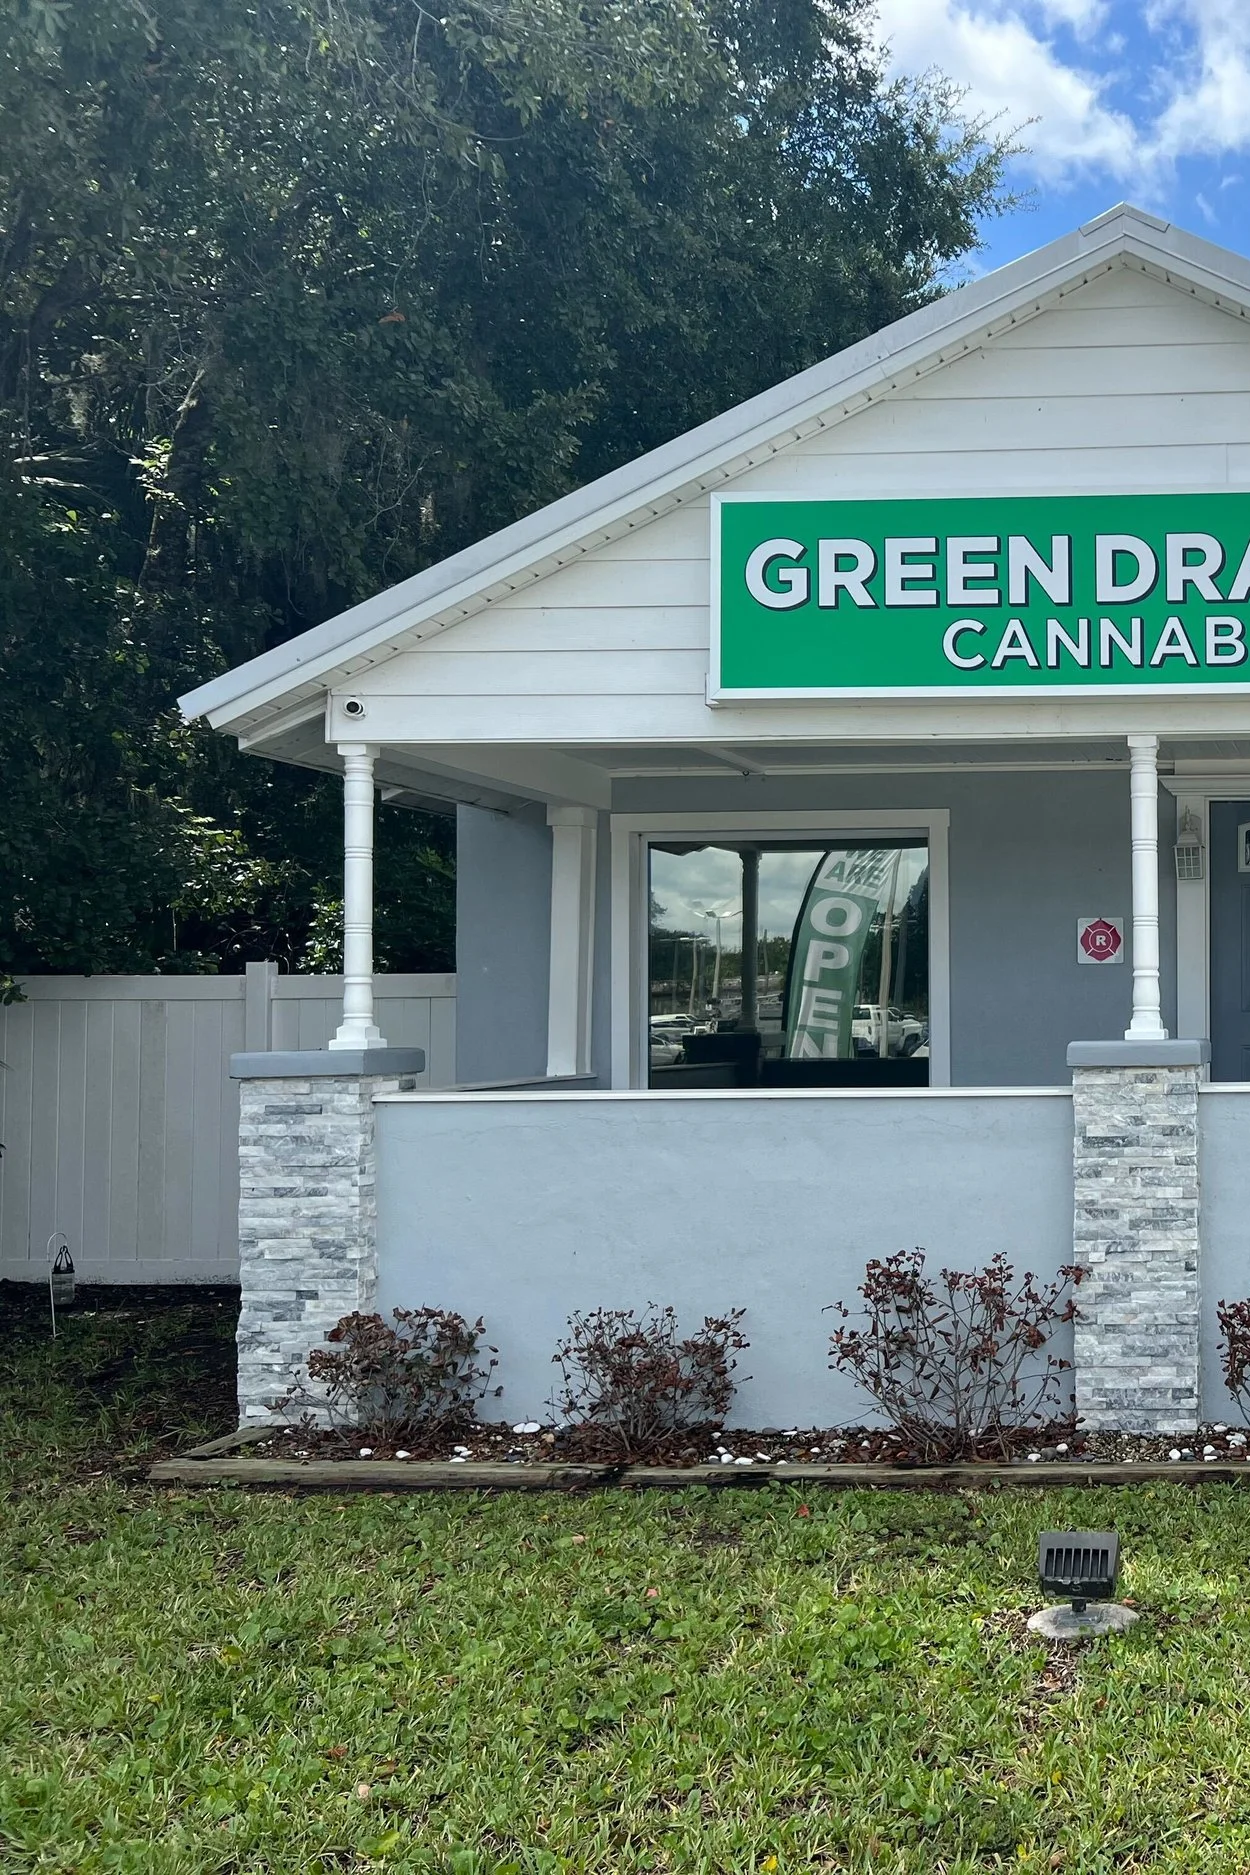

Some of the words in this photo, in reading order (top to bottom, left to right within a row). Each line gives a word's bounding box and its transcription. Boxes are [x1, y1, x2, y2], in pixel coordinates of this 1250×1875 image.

[744, 534, 1073, 612] GREEN
[790, 897, 863, 1059] OPEN
[1095, 935, 1107, 946] R
